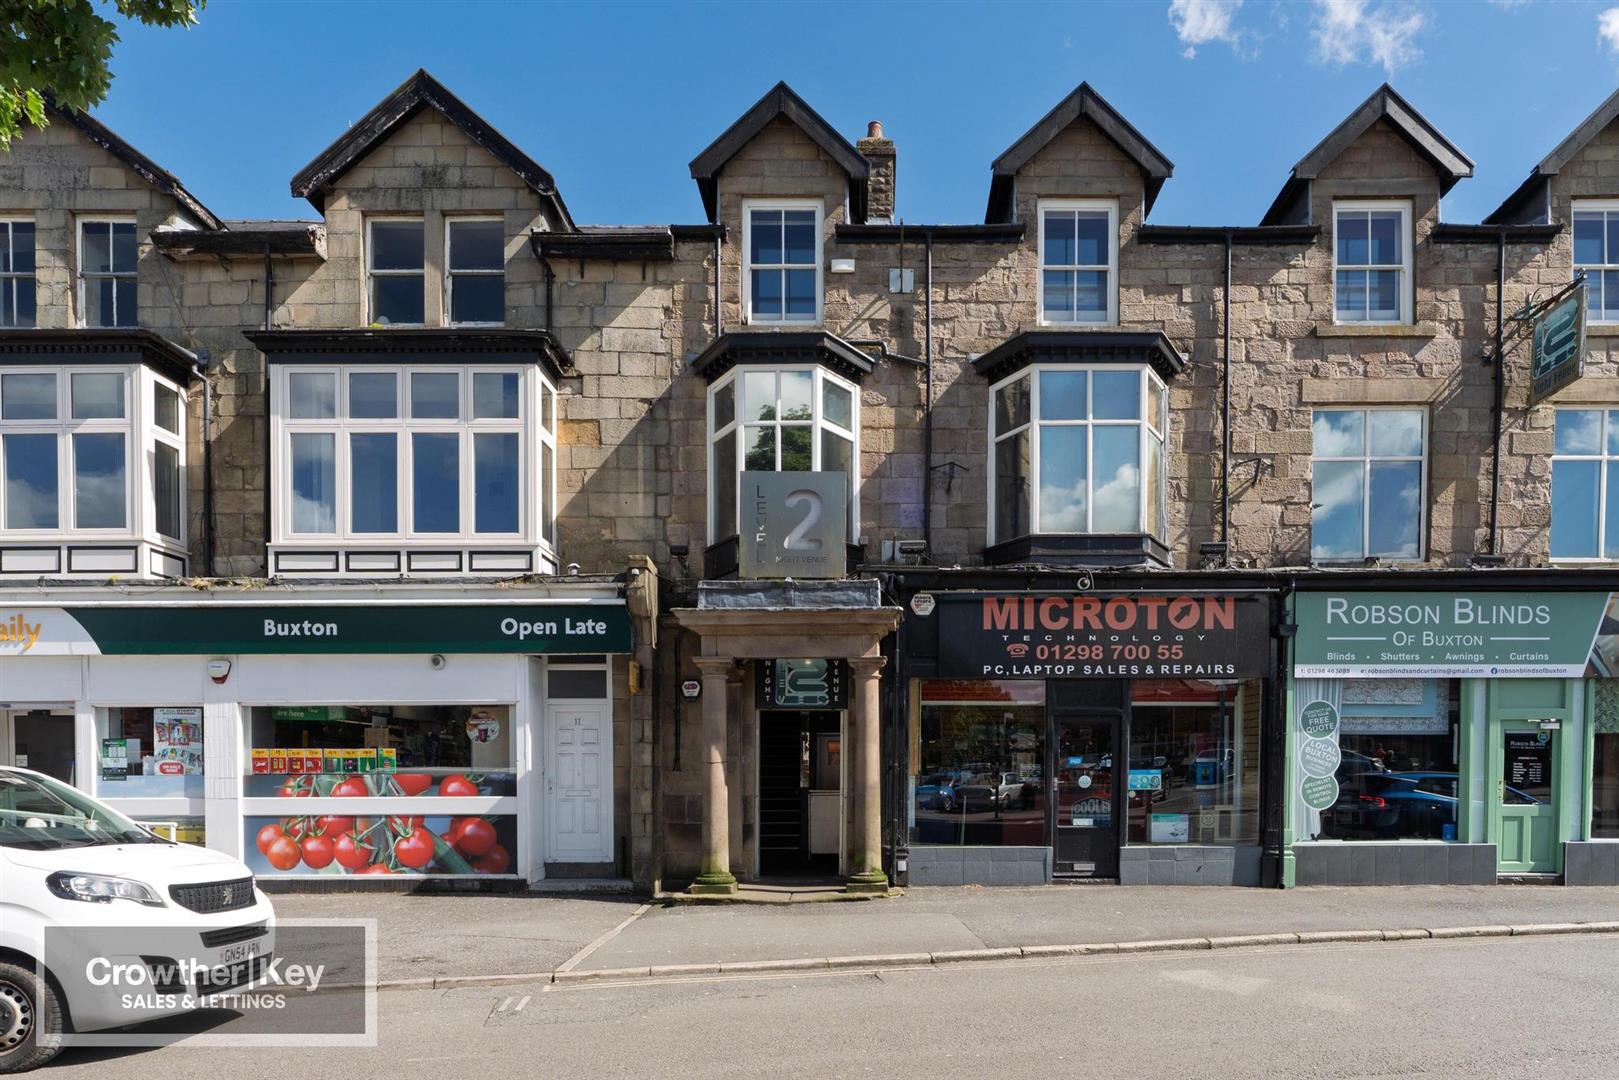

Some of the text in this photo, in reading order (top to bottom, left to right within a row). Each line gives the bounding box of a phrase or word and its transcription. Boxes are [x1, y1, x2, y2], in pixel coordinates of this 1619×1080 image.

[784, 488, 823, 550] 2
[801, 555, 828, 564] VENUE
[982, 596, 1235, 631] MICROTON
[1326, 597, 1551, 625] ROBSON BLINDS
[263, 619, 338, 636] Buxton
[500, 617, 607, 640] Open Late
[1001, 634, 1206, 642] TECHNOLOGY
[1422, 631, 1483, 647] BUXTON
[1035, 644, 1184, 661] 01298 700 55
[1326, 652, 1549, 664] Blinds Shutters Awnings Curtains
[1083, 664, 1140, 675] SALES
[1145, 664, 1155, 675] &
[1160, 664, 1236, 675] REPAIRS
[764, 660, 772, 703] NIGHT
[1305, 722, 1335, 734] QUOTE
[1308, 716, 1330, 726] FREE
[1304, 746, 1339, 764] BUXTON
[1310, 740, 1337, 756] LOCAL
